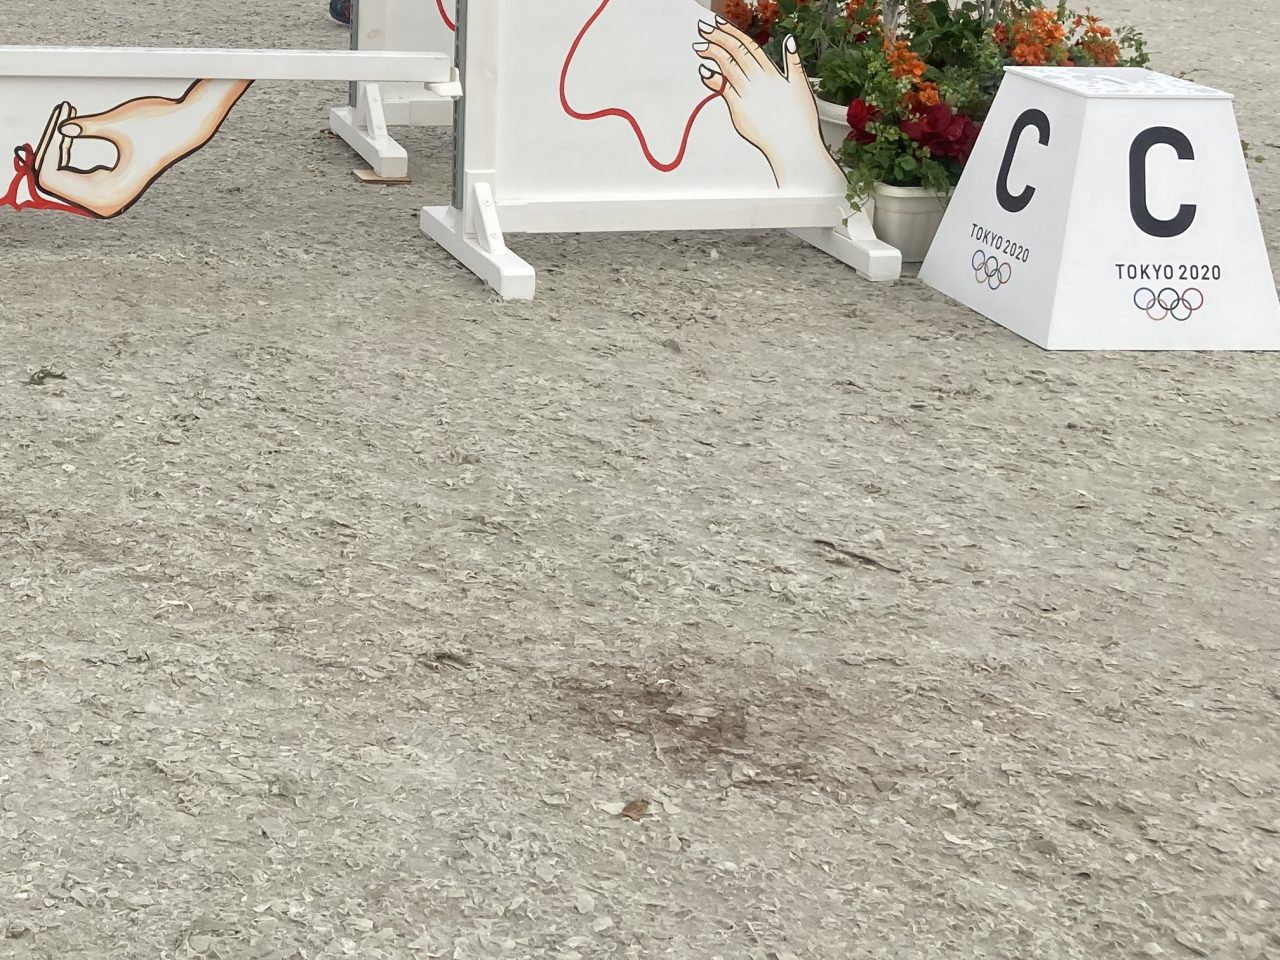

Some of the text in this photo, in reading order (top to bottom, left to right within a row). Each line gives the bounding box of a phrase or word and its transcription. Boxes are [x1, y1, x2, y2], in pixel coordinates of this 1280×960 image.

[996, 108, 1051, 213] C
[1129, 126, 1197, 238] C
[970, 223, 1030, 263] TOKYO 2020
[1115, 264, 1222, 280] TOKYO 2020
